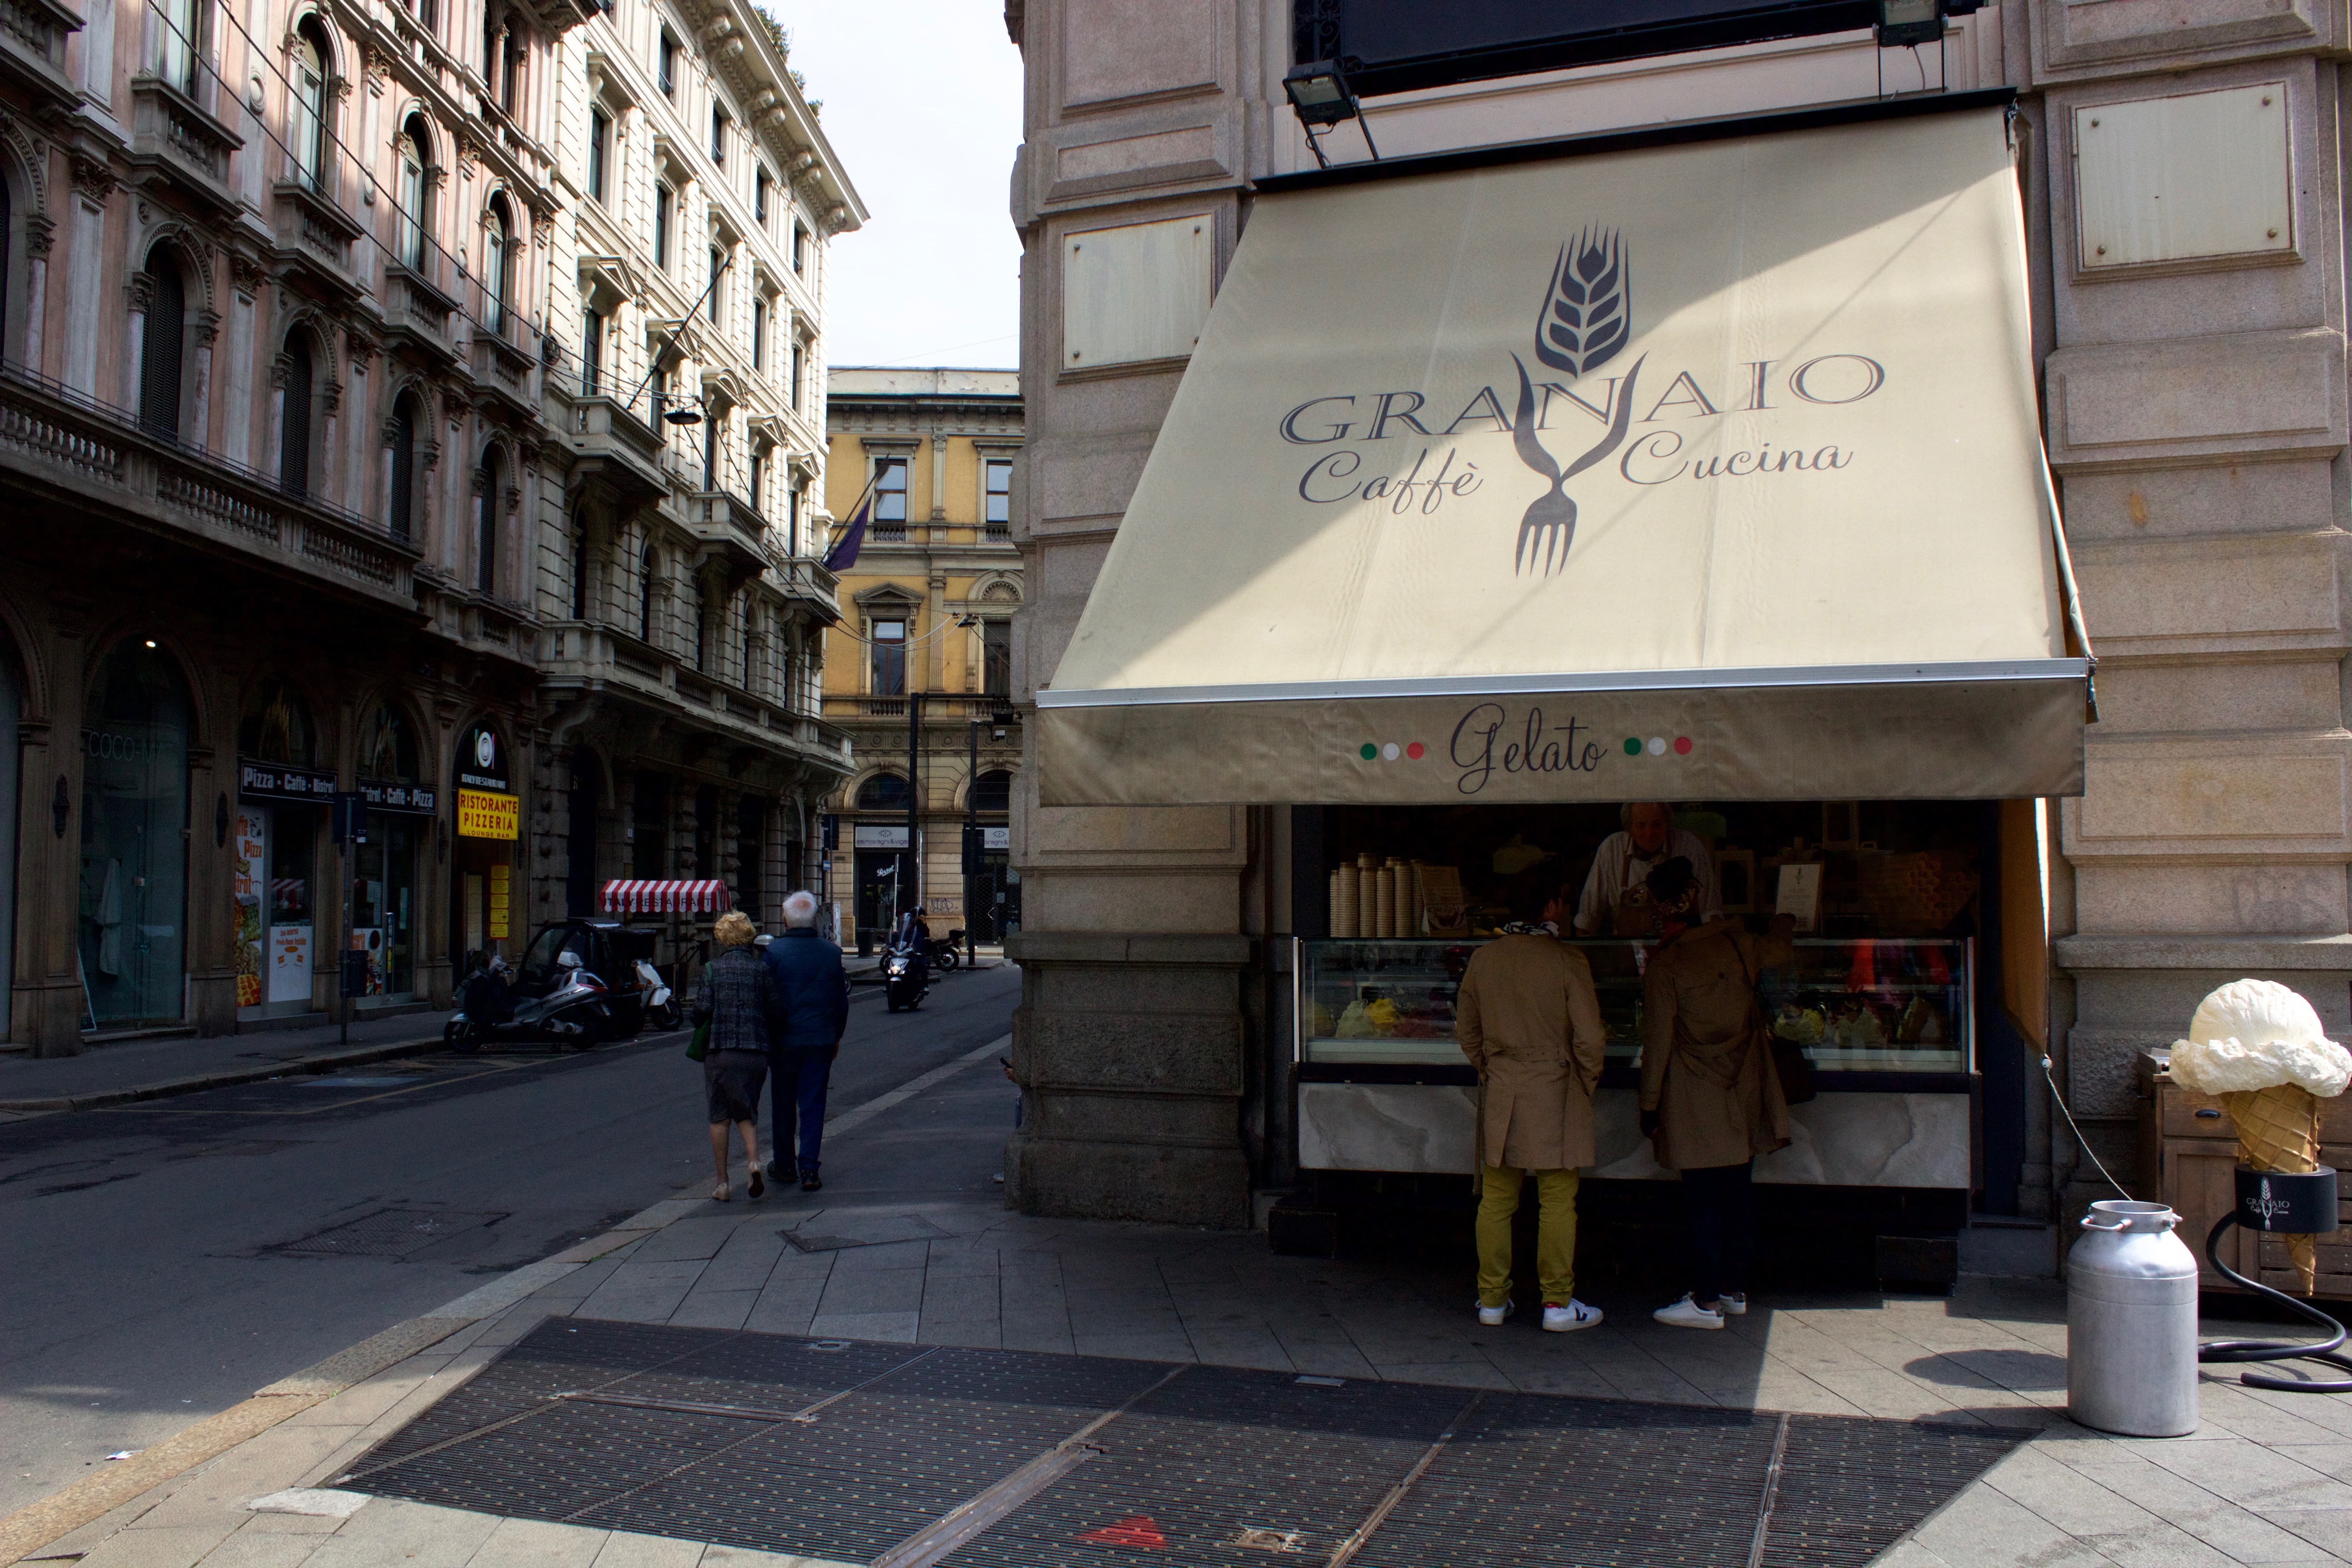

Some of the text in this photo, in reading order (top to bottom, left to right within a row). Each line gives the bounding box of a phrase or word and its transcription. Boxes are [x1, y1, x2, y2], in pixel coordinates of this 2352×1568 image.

[1279, 353, 1886, 446] GRANAIO
[1298, 430, 1854, 515] Caffè Cucina
[1450, 703, 1608, 794] Gelato
[243, 767, 335, 794] Pizza Caffè Bistrot
[387, 787, 406, 805] Caffè
[412, 789, 434, 808] Pizza
[460, 794, 518, 814] RISTORANTE
[464, 812, 513, 831] PIZZERIA
[467, 829, 494, 838] LOUNGE
[244, 840, 262, 858] Pizza
[877, 864, 895, 877] Persol
[2246, 1197, 2290, 1208] GRANAIO
